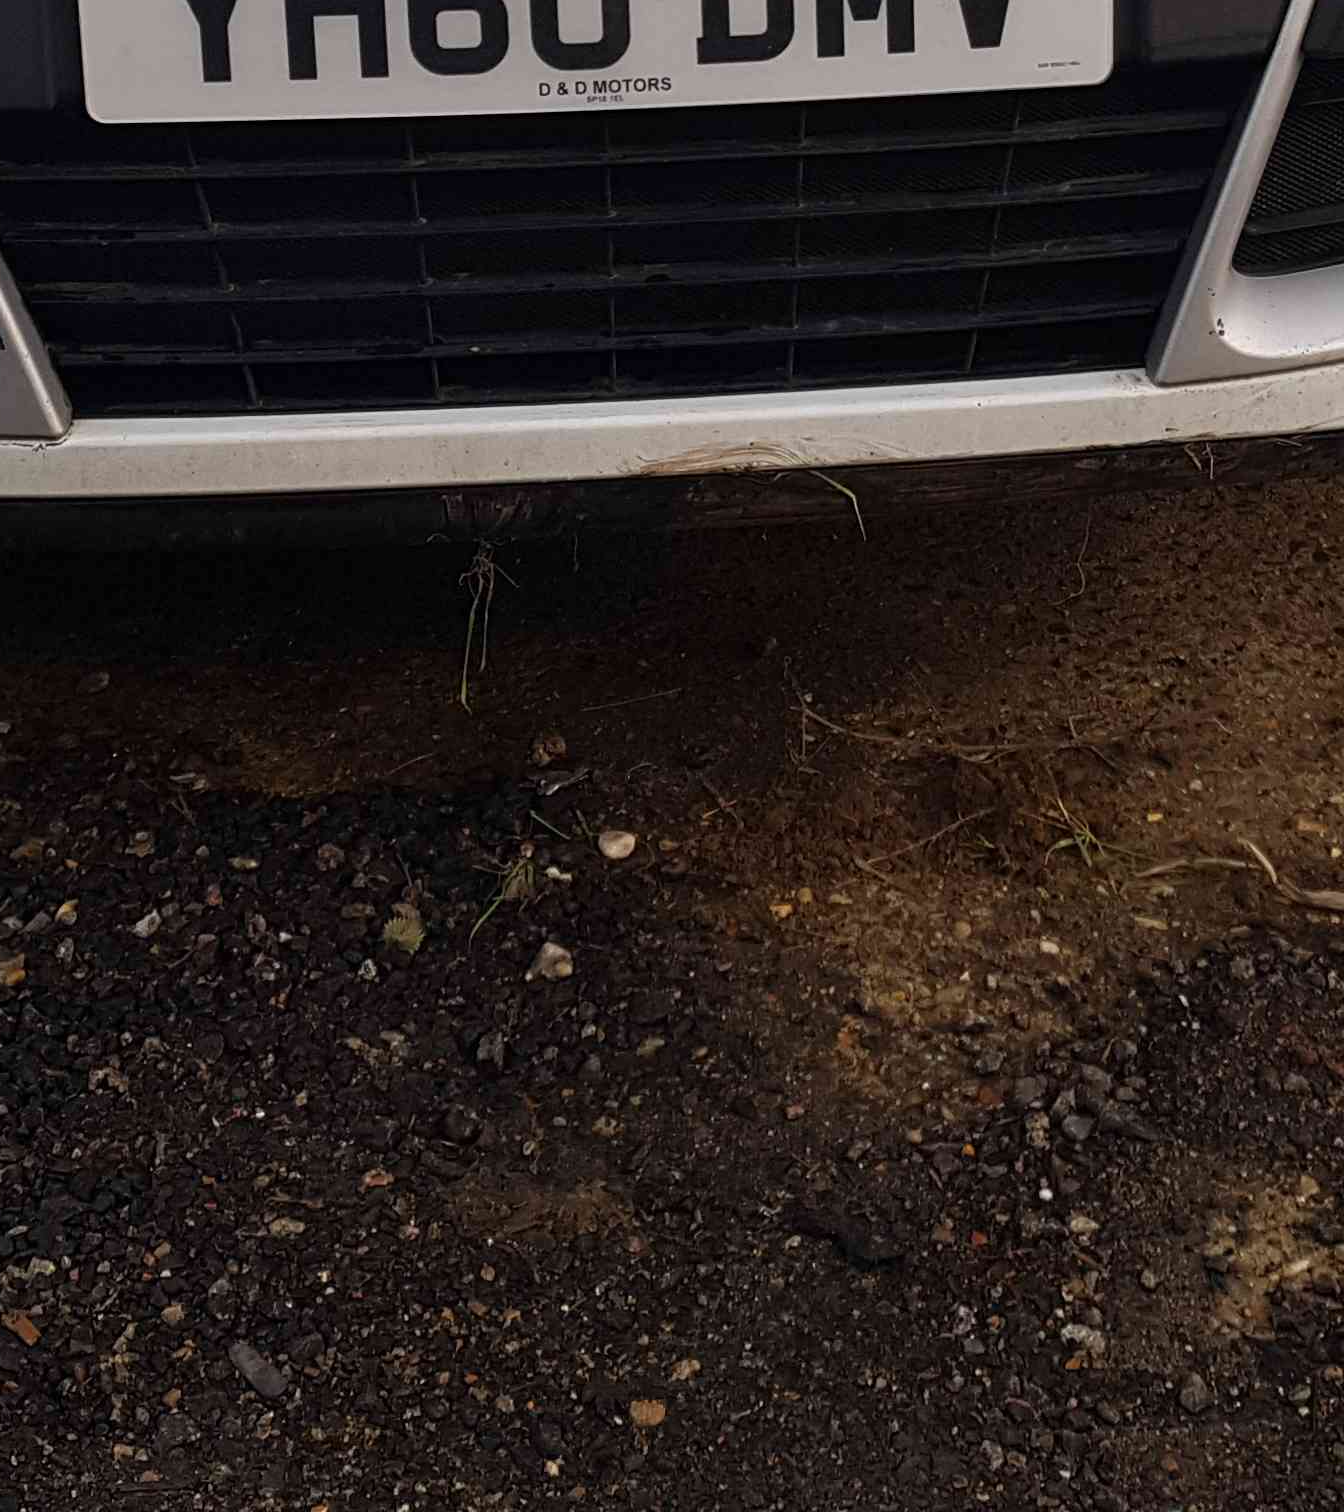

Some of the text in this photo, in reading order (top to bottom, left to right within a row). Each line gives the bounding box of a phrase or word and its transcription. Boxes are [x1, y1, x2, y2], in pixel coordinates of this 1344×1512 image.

[538, 76, 673, 97] D & D MOTORS
